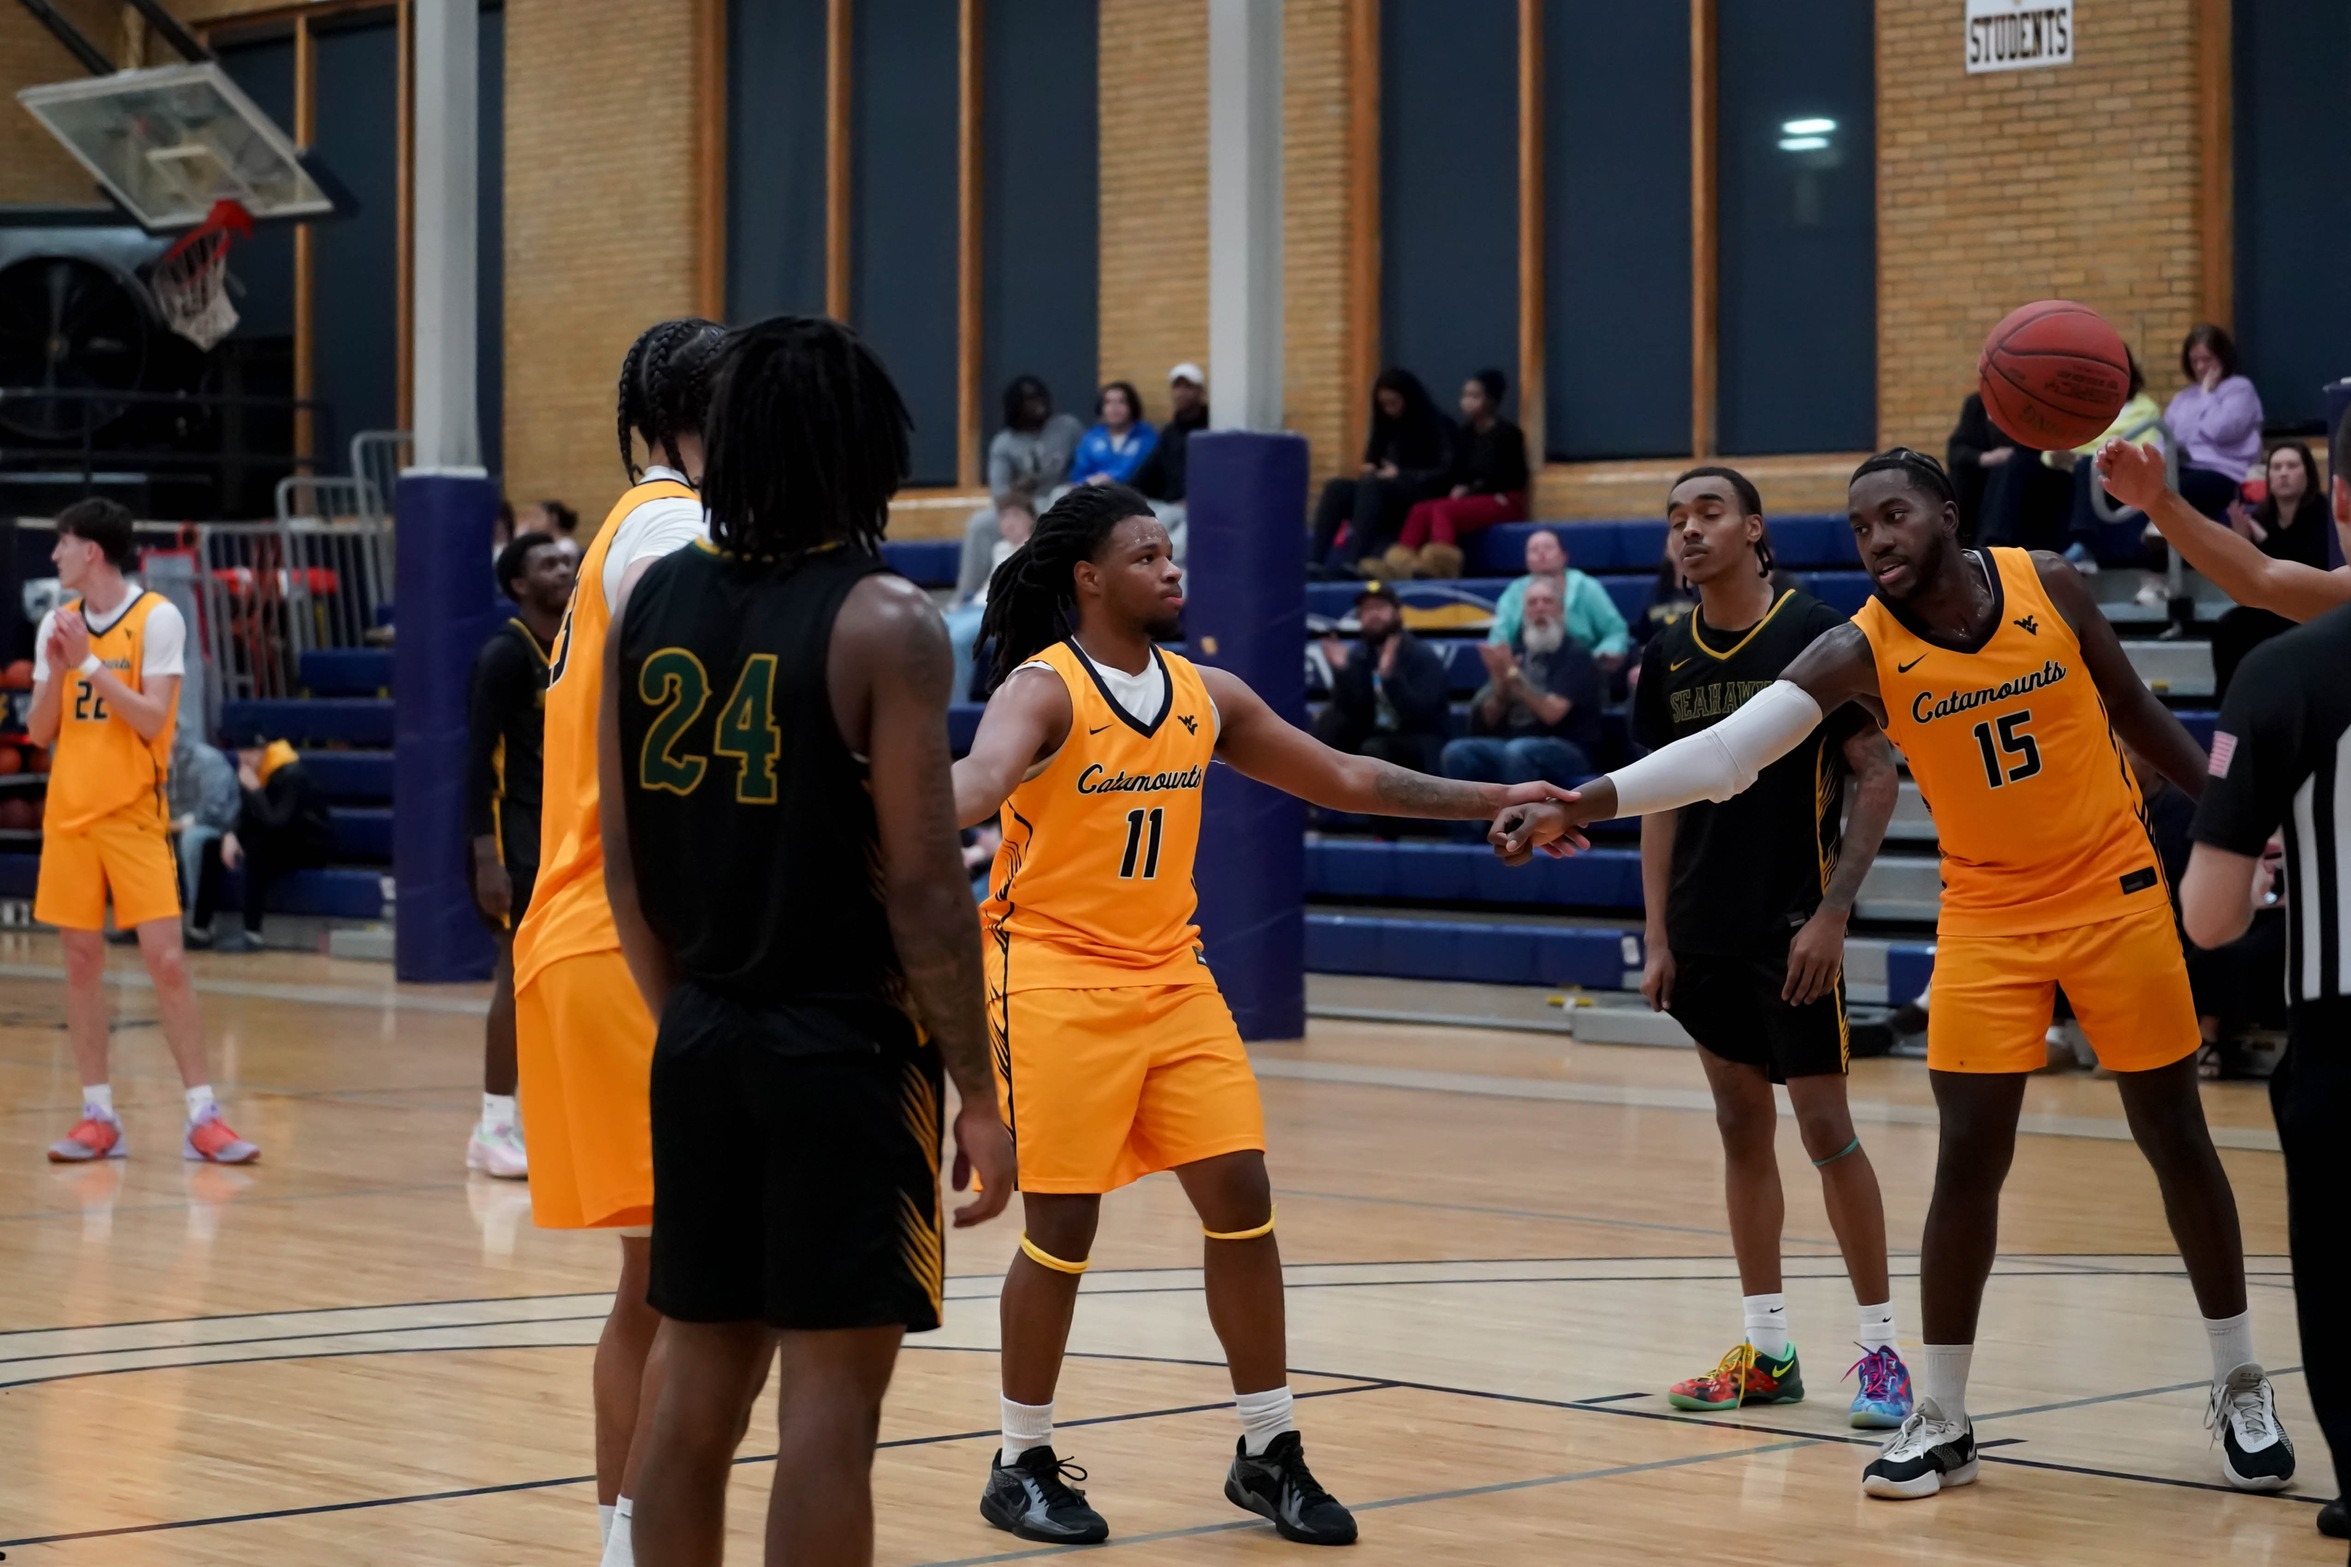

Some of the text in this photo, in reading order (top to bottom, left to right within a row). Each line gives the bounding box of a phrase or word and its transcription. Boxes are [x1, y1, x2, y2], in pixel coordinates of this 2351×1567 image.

[1970, 7, 2067, 63] STUDENTS
[639, 647, 781, 804] 24
[1669, 680, 1773, 723] SEAHAW
[1911, 659, 2067, 725] Catamounts
[1972, 708, 2042, 790] 15
[1118, 807, 1164, 880] 11
